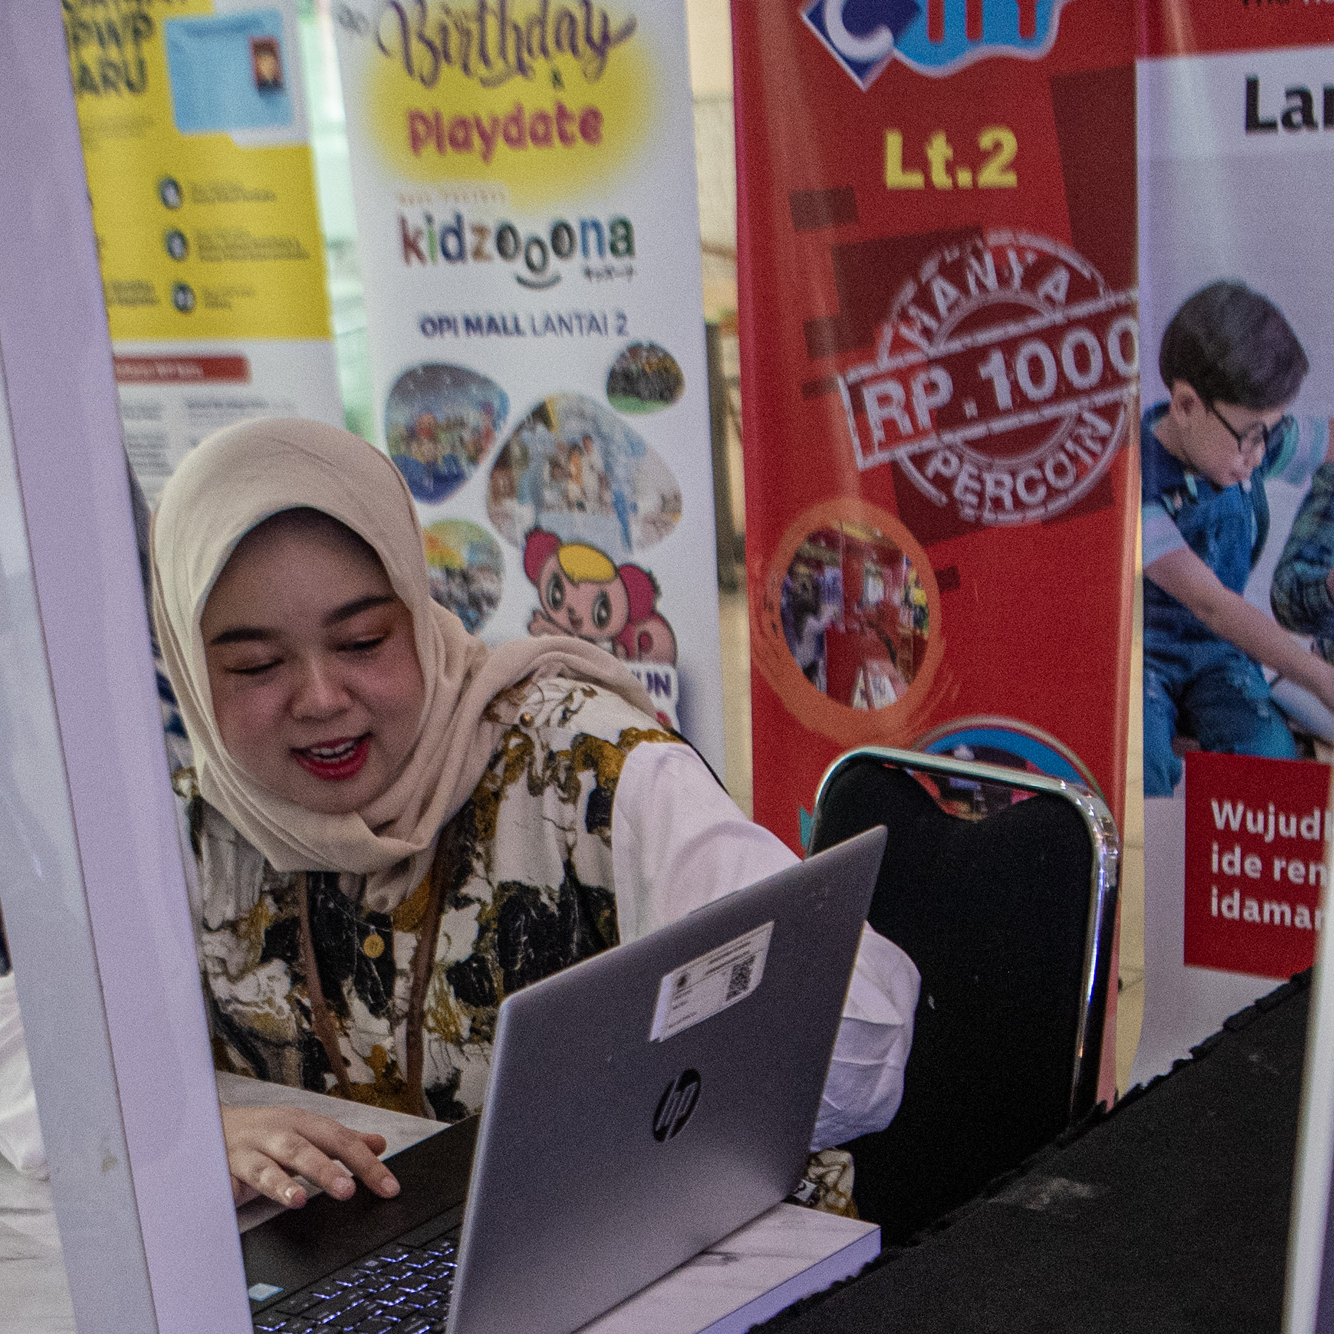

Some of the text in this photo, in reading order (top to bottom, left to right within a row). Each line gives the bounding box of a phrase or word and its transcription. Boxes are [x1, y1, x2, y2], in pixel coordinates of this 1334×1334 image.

[70, 12, 155, 50] PWP
[77, 58, 149, 96] ARU
[407, 102, 604, 163] Playdate
[884, 127, 1019, 191] Lt.2
[398, 209, 636, 275] kidzooona
[420, 309, 629, 339] OPI MALL LANTAI 2
[862, 316, 1139, 445] RP.1000
[925, 410, 1113, 515] PERCOIN
[1211, 840, 1330, 887] ide ren
